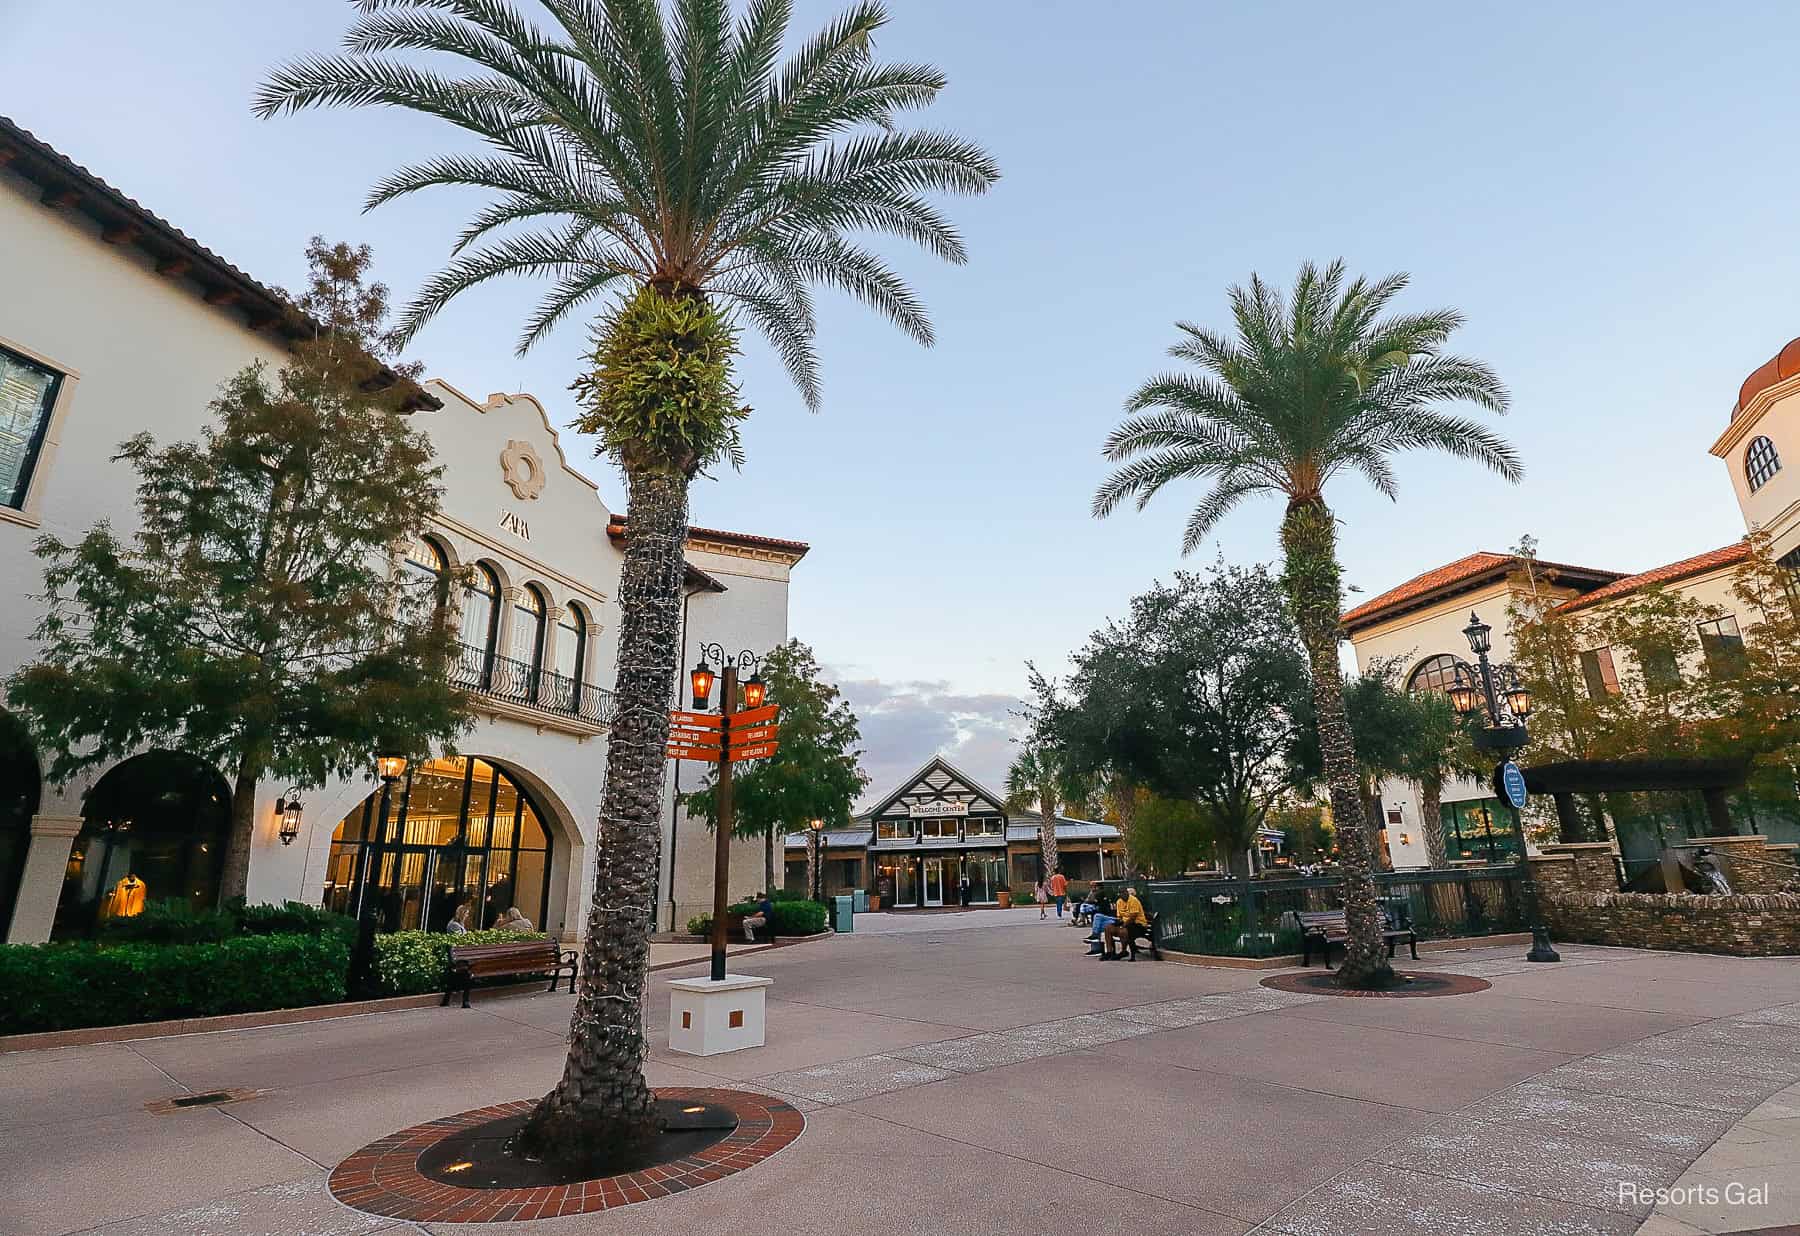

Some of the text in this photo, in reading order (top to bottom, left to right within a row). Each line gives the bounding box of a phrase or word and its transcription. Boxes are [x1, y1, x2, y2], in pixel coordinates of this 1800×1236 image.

[498, 508, 531, 542] ZARA
[912, 804, 965, 813] WELCOME CENTER
